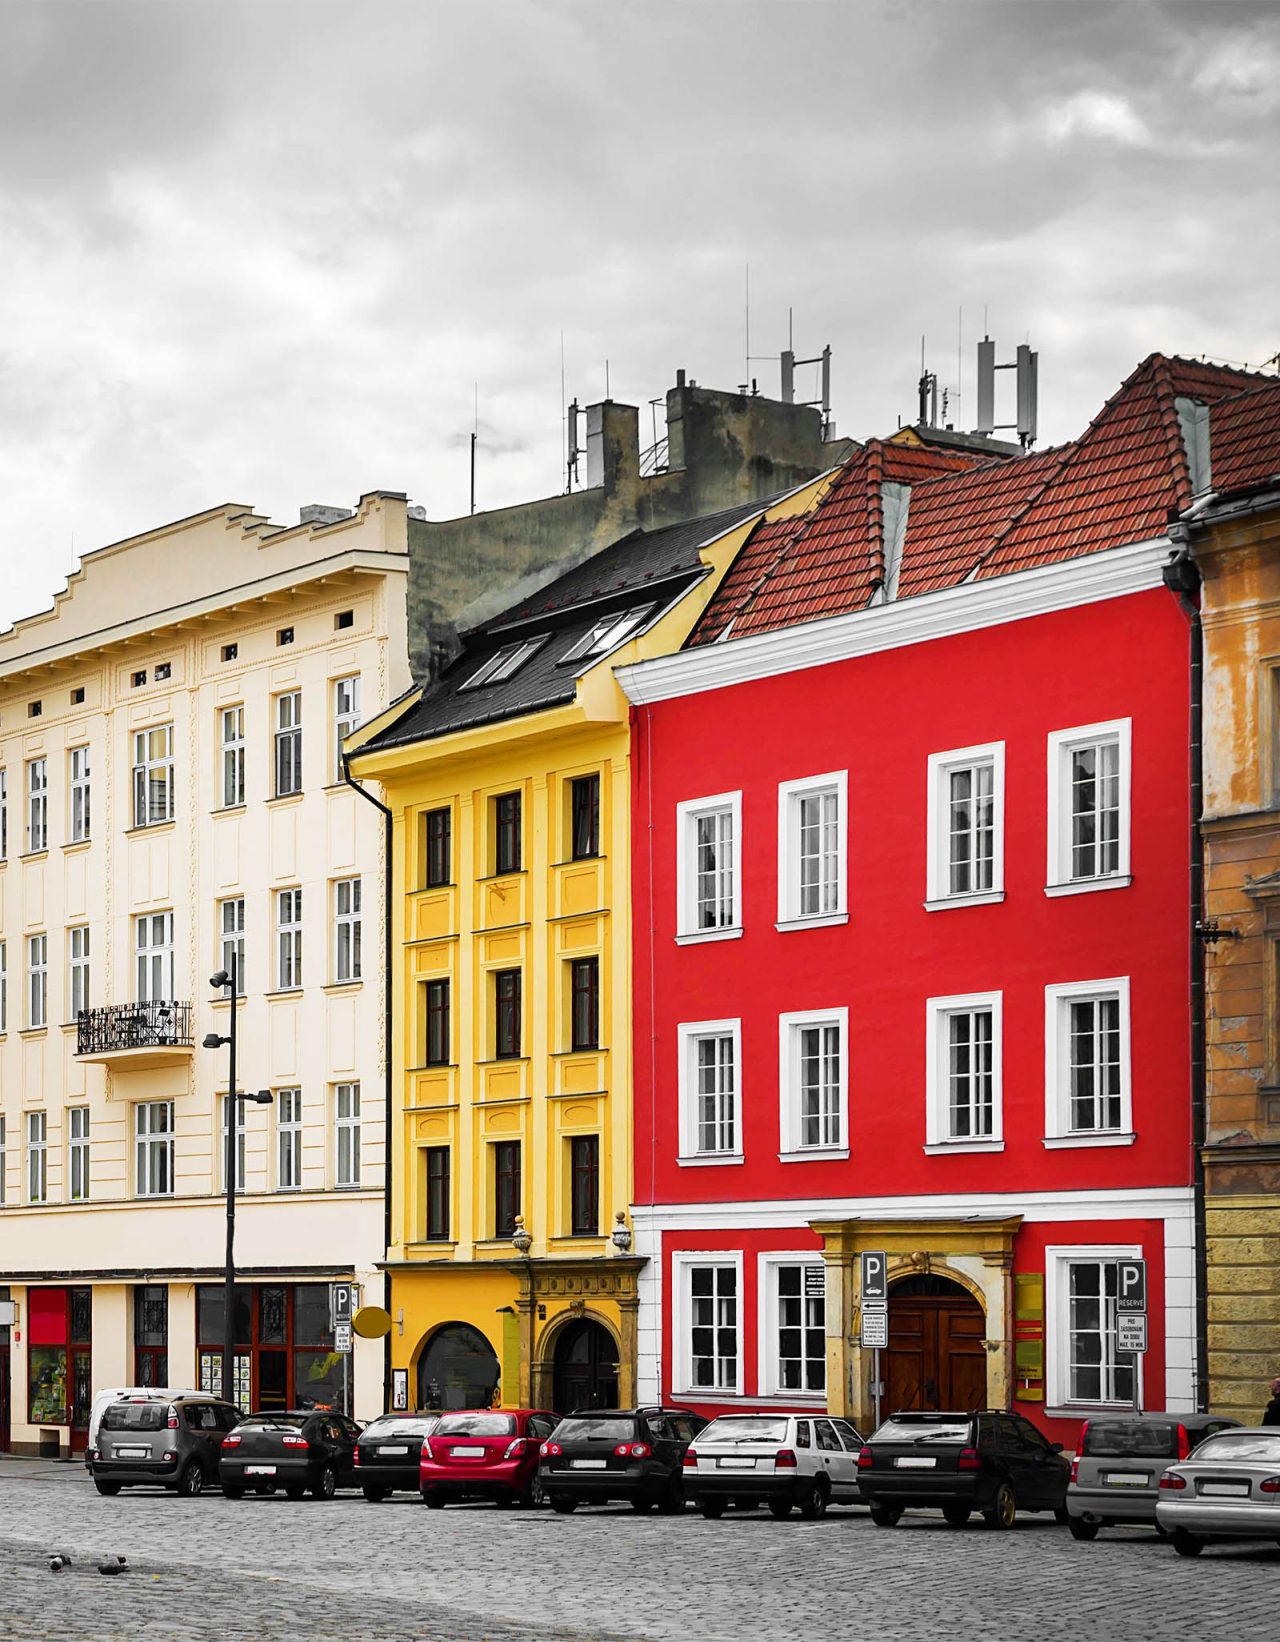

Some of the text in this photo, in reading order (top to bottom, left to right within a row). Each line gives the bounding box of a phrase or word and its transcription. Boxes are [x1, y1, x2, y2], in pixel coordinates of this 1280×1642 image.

[867, 1257, 880, 1284] P
[1123, 1266, 1139, 1296] P
[338, 1289, 348, 1312] P
